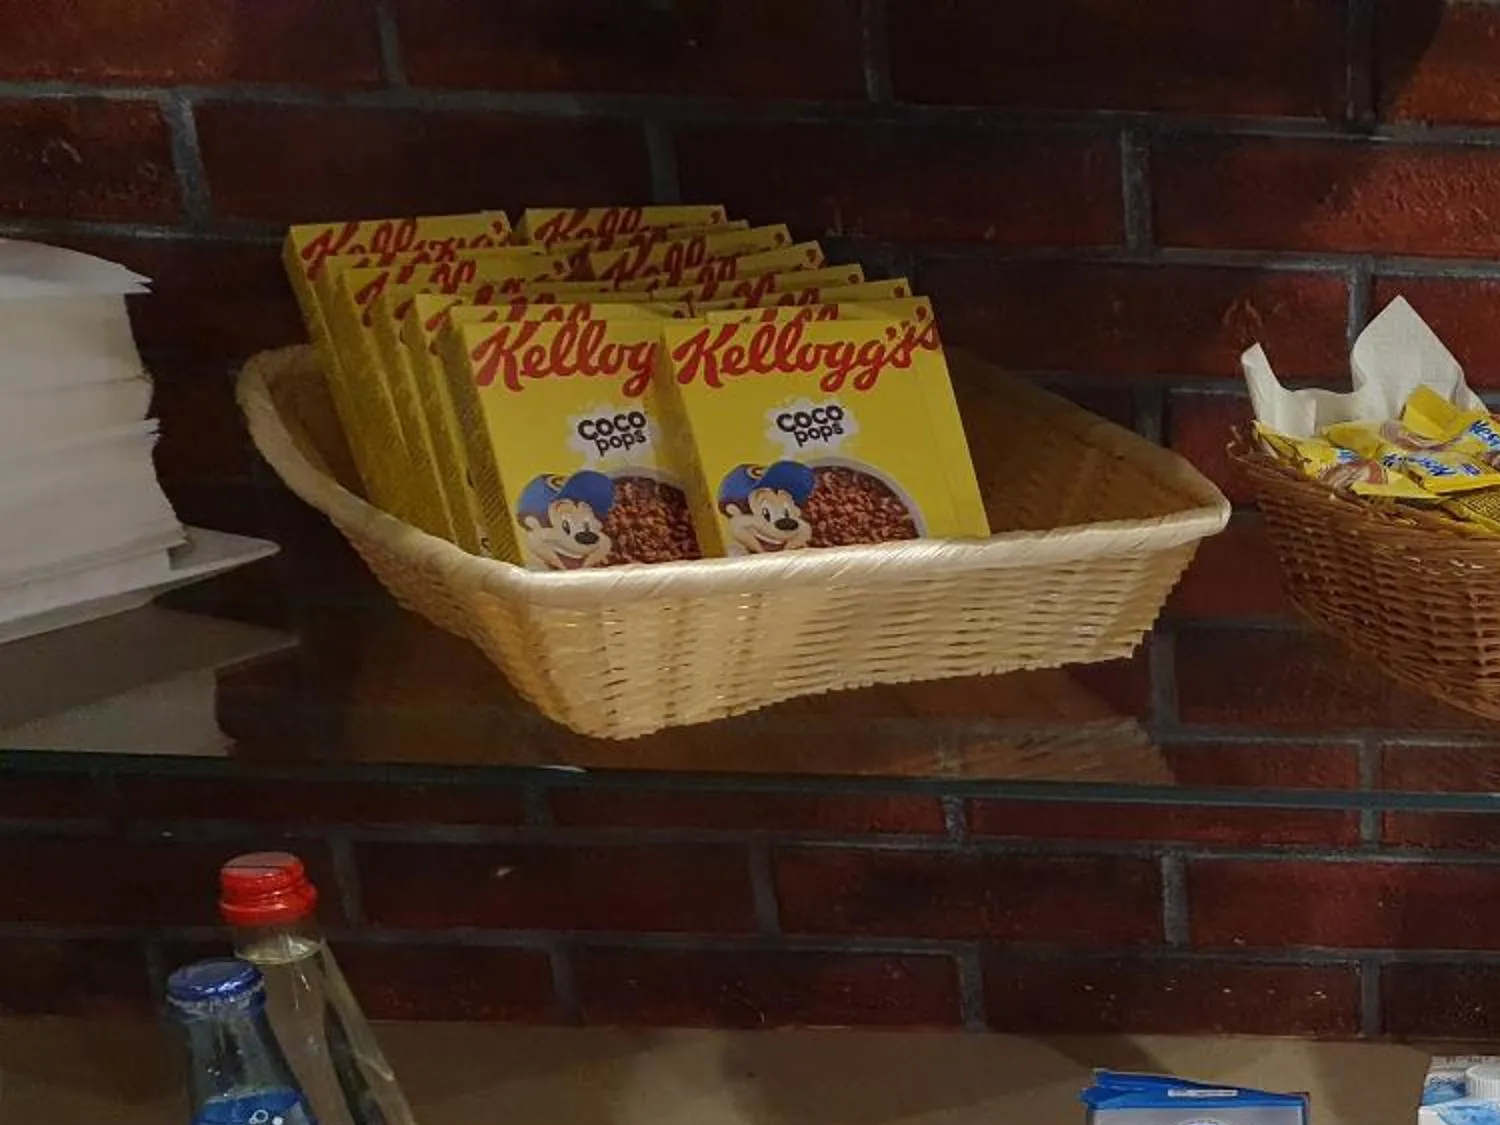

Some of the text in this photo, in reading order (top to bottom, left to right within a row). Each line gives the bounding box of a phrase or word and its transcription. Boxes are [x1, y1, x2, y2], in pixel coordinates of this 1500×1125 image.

[472, 318, 659, 397] Kellog
[672, 318, 914, 393] Kellogg's
[595, 430, 646, 457] pops
[794, 423, 844, 447] pops
